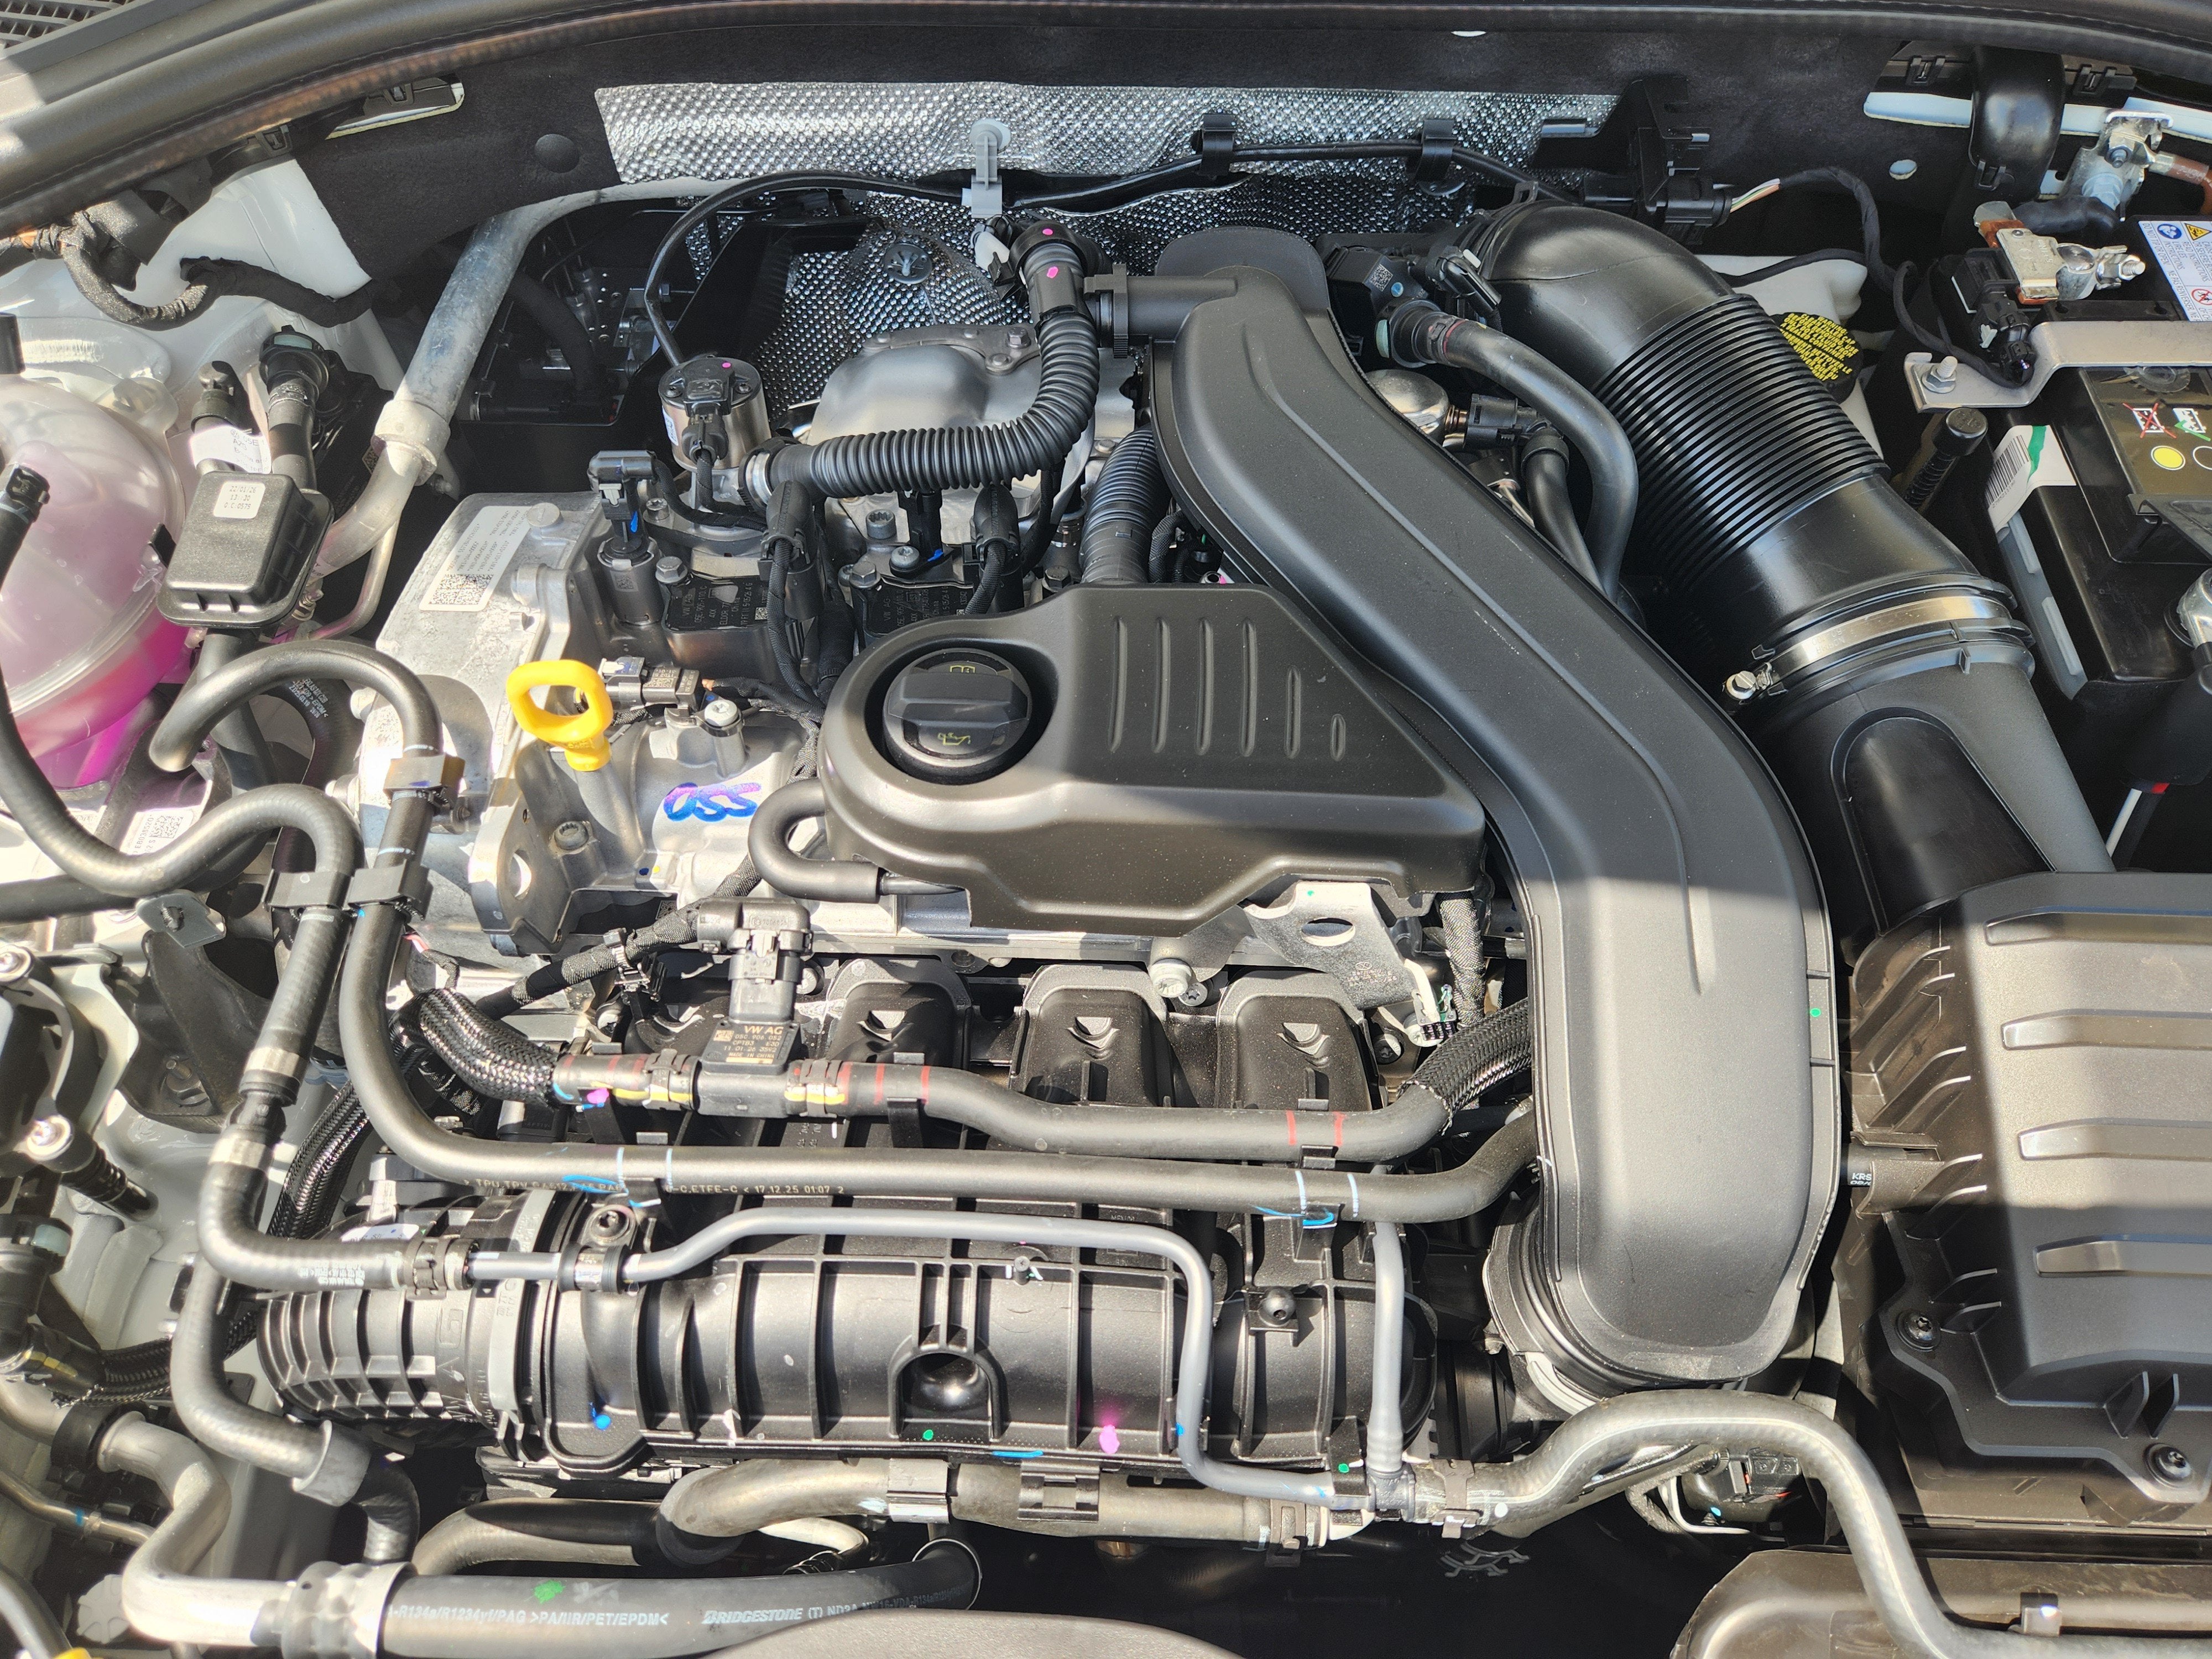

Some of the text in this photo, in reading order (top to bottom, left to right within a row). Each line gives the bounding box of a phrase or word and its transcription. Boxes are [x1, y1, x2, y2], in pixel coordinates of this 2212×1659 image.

[1783, 316, 1802, 330] ONLY
[1816, 335, 1837, 348] FLUID
[1834, 345, 1854, 359] FROM
[1785, 324, 1811, 341] SEALED
[1787, 312, 1814, 329] BEFORE
[1844, 343, 1859, 354] USE
[1799, 312, 1856, 346] CLEAN FILLER CAP
[1841, 366, 1853, 374] LE
[744, 1025, 784, 1035] VW AG
[755, 1185, 799, 1194] 17.12.25
[701, 1607, 804, 1625] BRIDGESTONE
